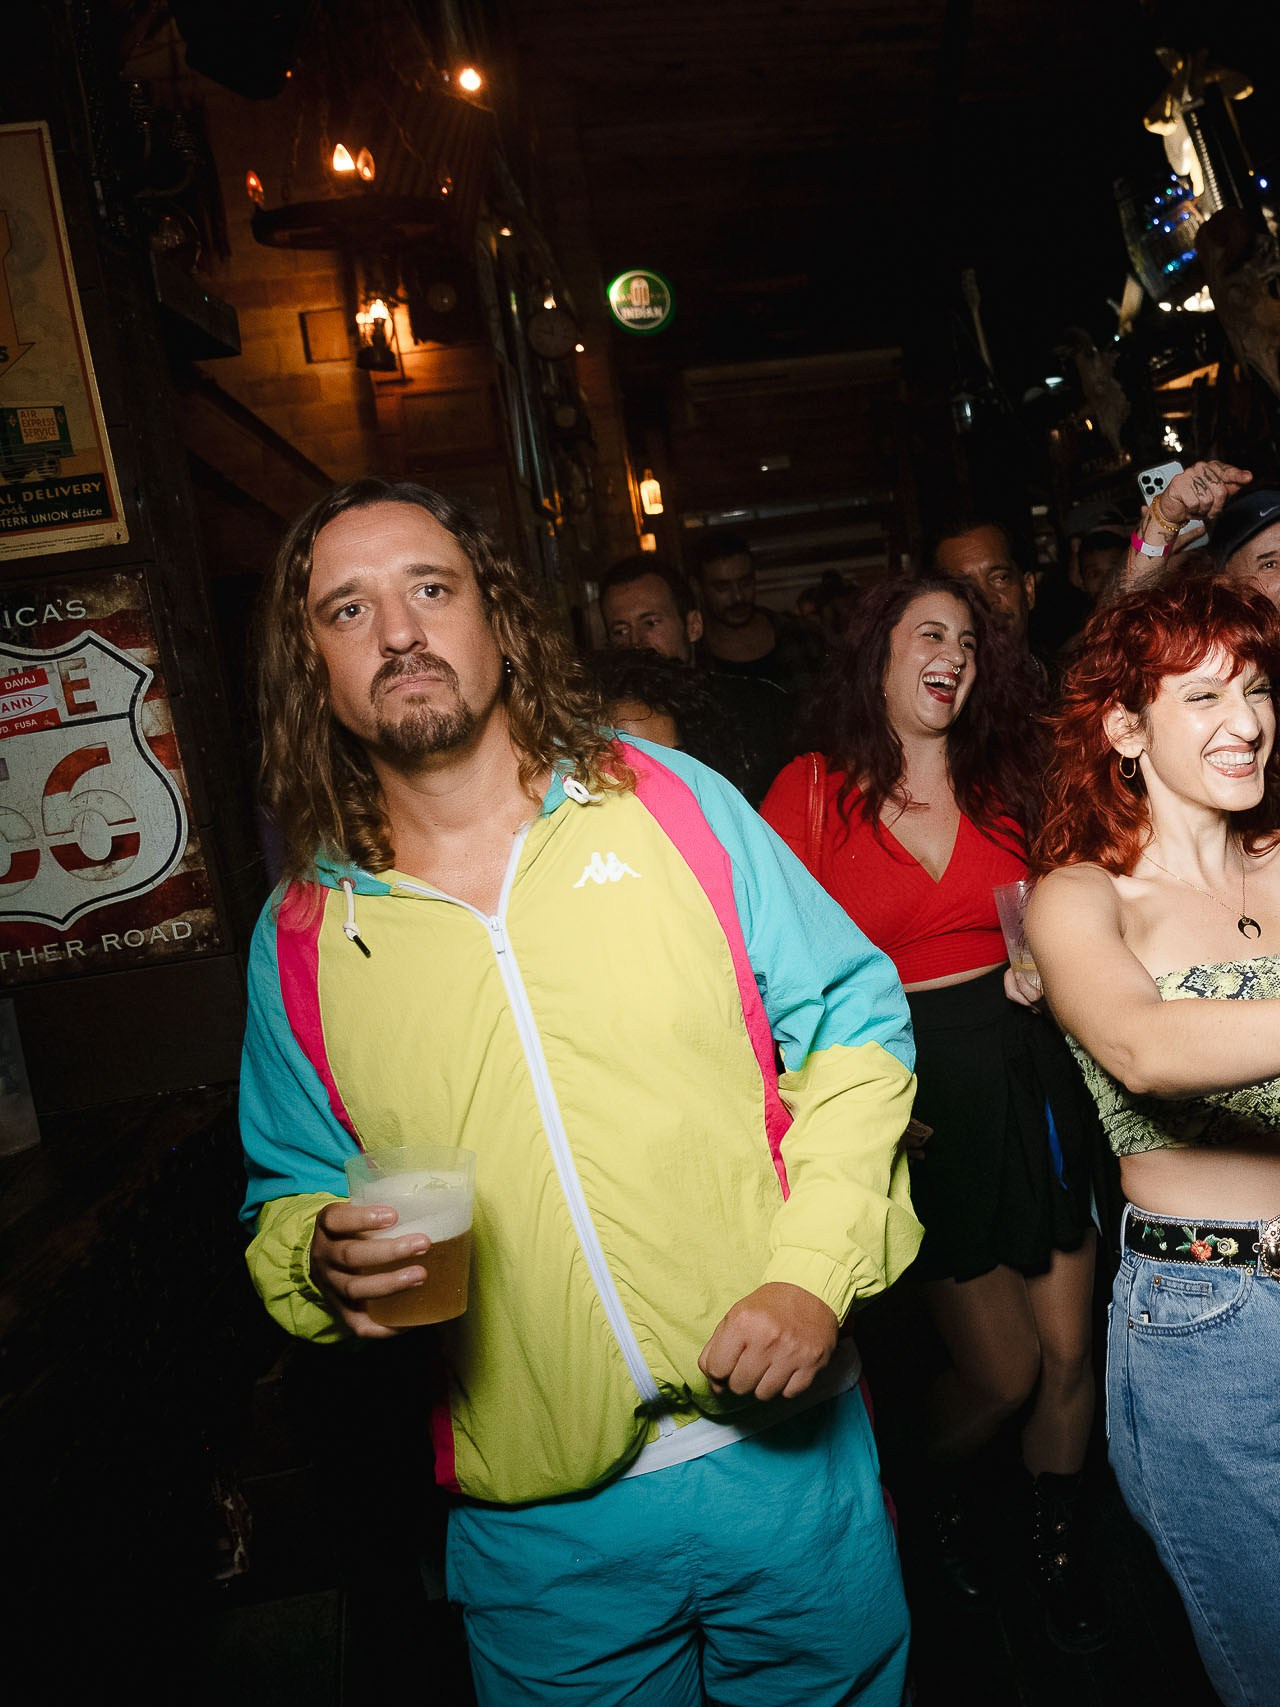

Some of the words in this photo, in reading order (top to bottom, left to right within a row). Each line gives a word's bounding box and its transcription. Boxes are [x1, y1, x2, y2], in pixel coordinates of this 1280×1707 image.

[20, 409, 38, 418] AIR
[22, 417, 56, 428] EXPRESS
[23, 426, 57, 438] SERVICE
[21, 481, 102, 503] DELIVERY
[31, 510, 69, 524] UNION
[71, 507, 103, 519] office
[4, 675, 37, 690] DAVAJ
[14, 719, 38, 730] FUSA
[101, 921, 193, 952] ROAD
